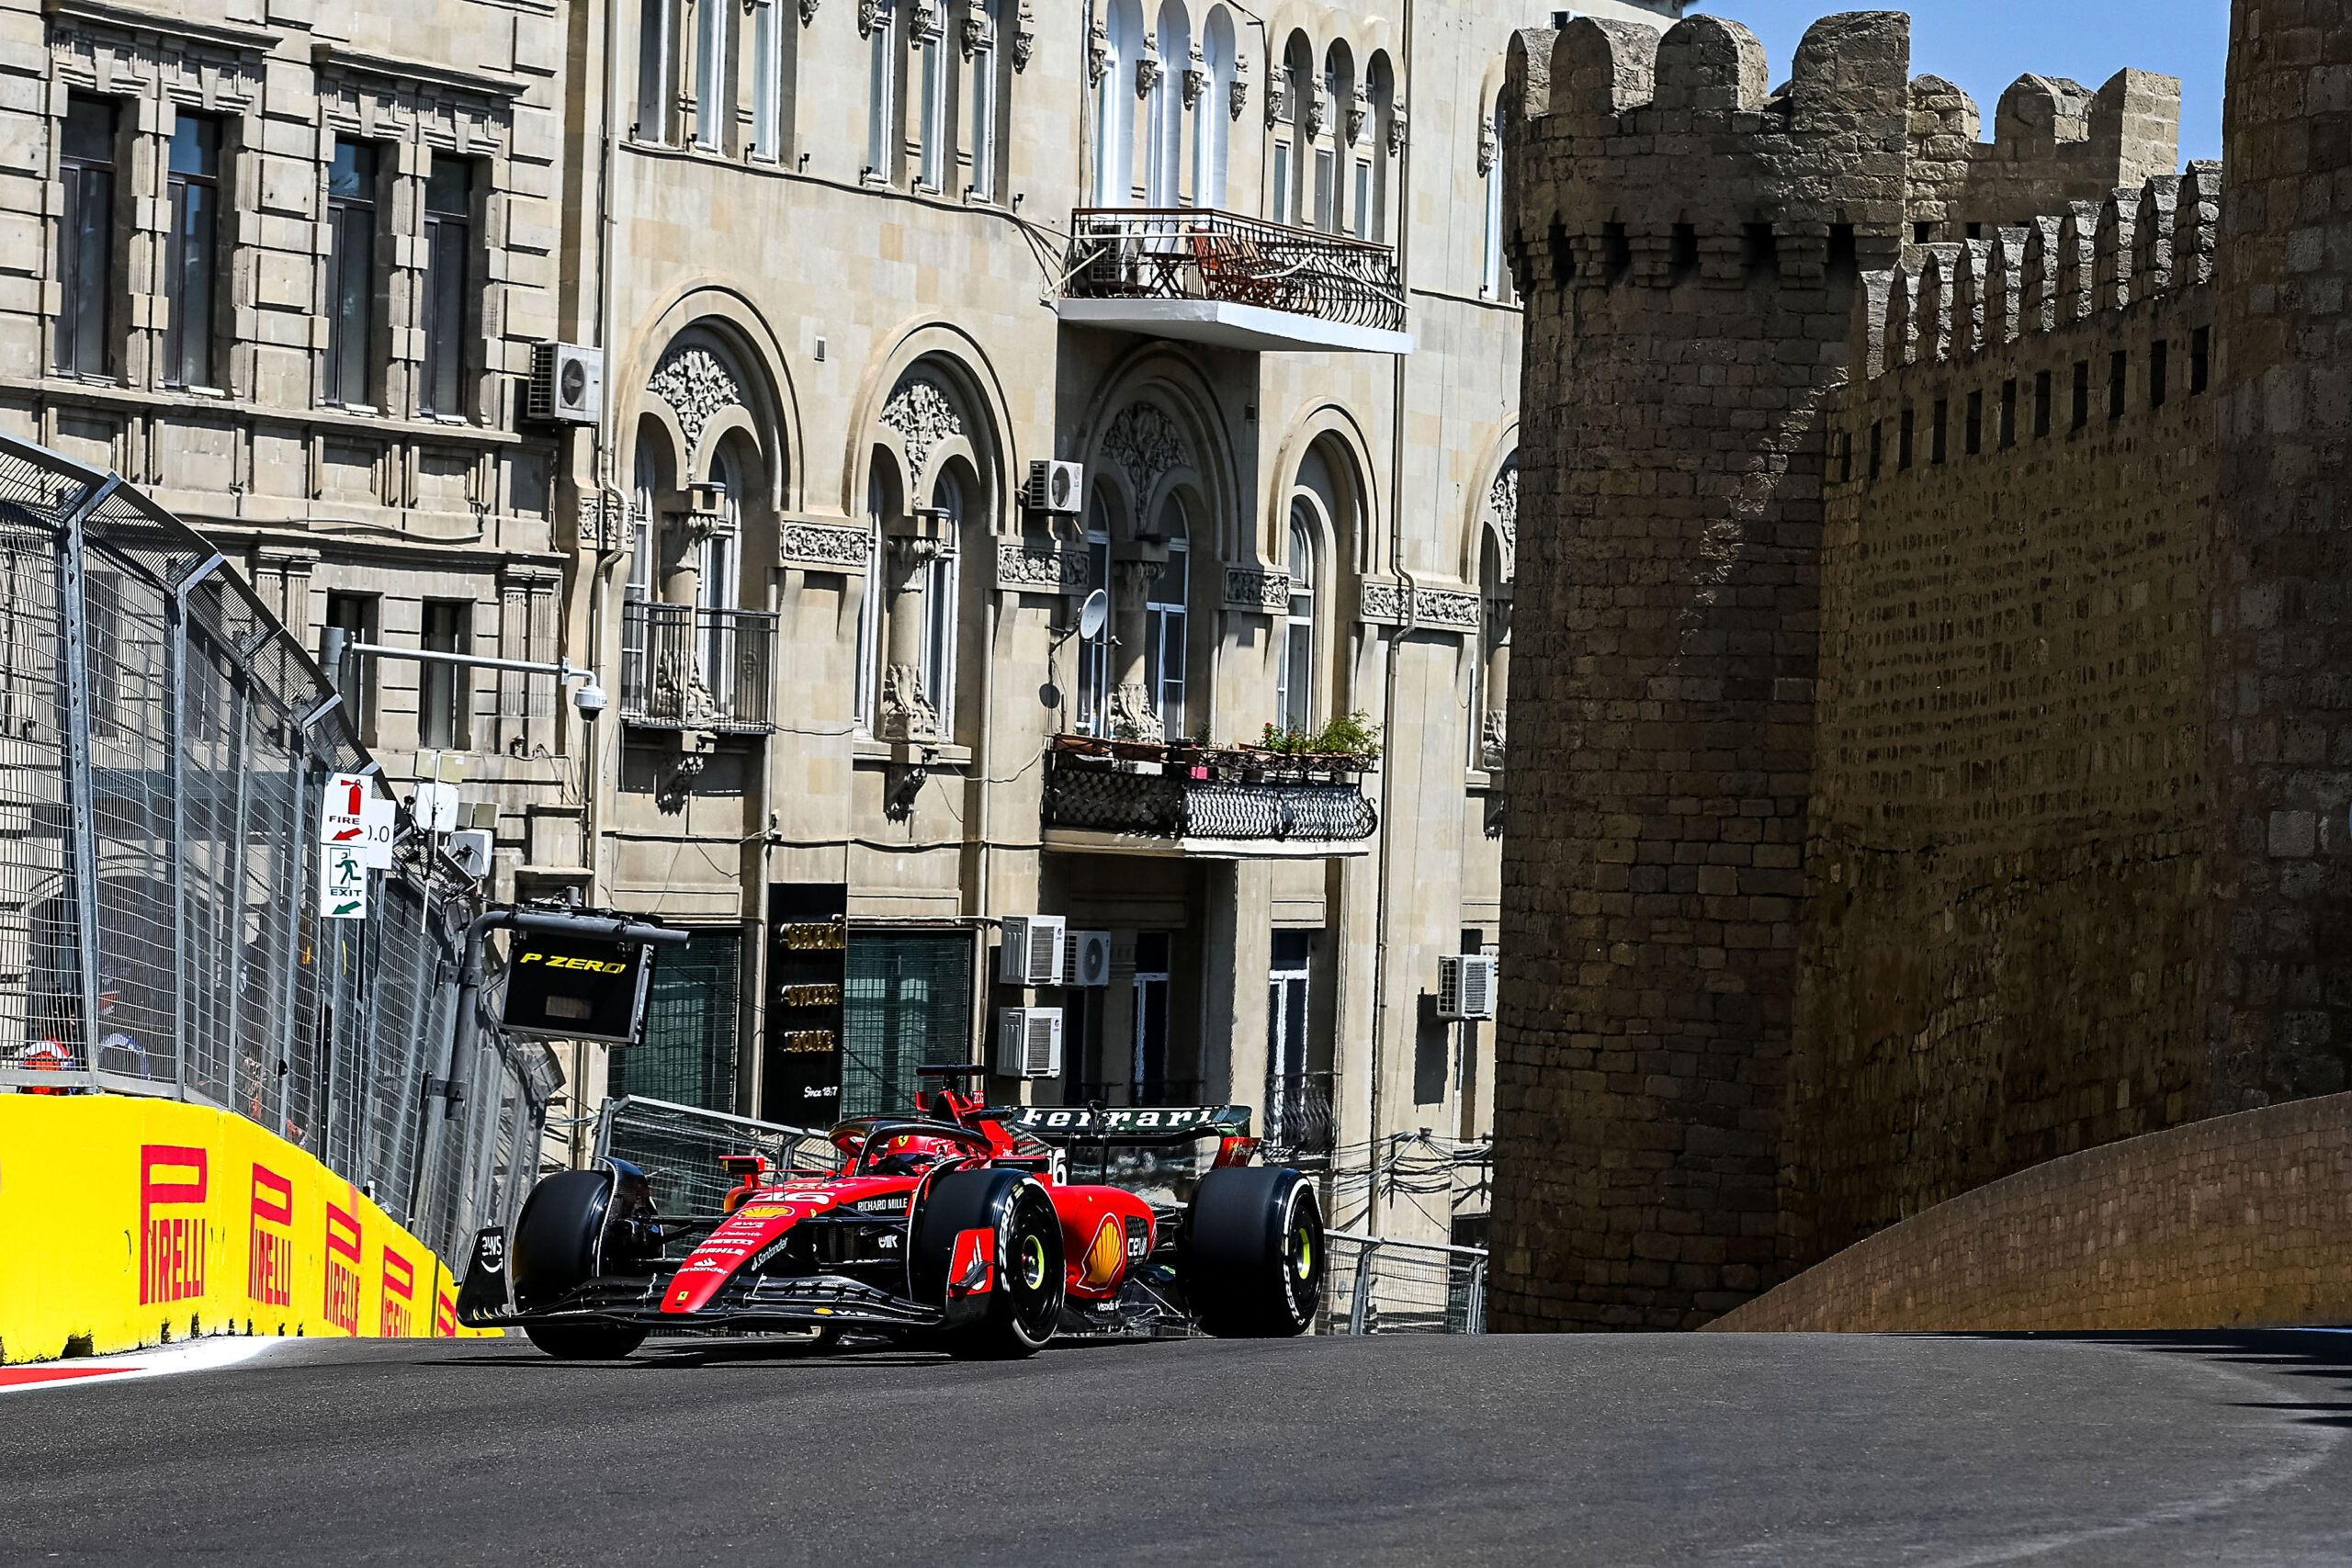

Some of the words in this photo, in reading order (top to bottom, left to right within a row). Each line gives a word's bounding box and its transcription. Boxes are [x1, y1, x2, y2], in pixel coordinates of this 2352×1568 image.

[329, 815, 360, 825] FIRE
[330, 888, 362, 897] EXIT
[520, 953, 543, 964] P
[545, 955, 626, 974] ZERO
[784, 1031, 835, 1053] HOME
[1017, 1107, 1212, 1127] Ferrari
[746, 1191, 835, 1205] 16
[857, 1199, 887, 1212] RICHARD
[888, 1197, 908, 1209] MILLE
[140, 1145, 208, 1305] PIRELLI
[248, 1162, 292, 1307] PIRELLI
[999, 1194, 1014, 1269] ZERO
[758, 1236, 788, 1267] Santander
[324, 1201, 361, 1337] PIRELLI
